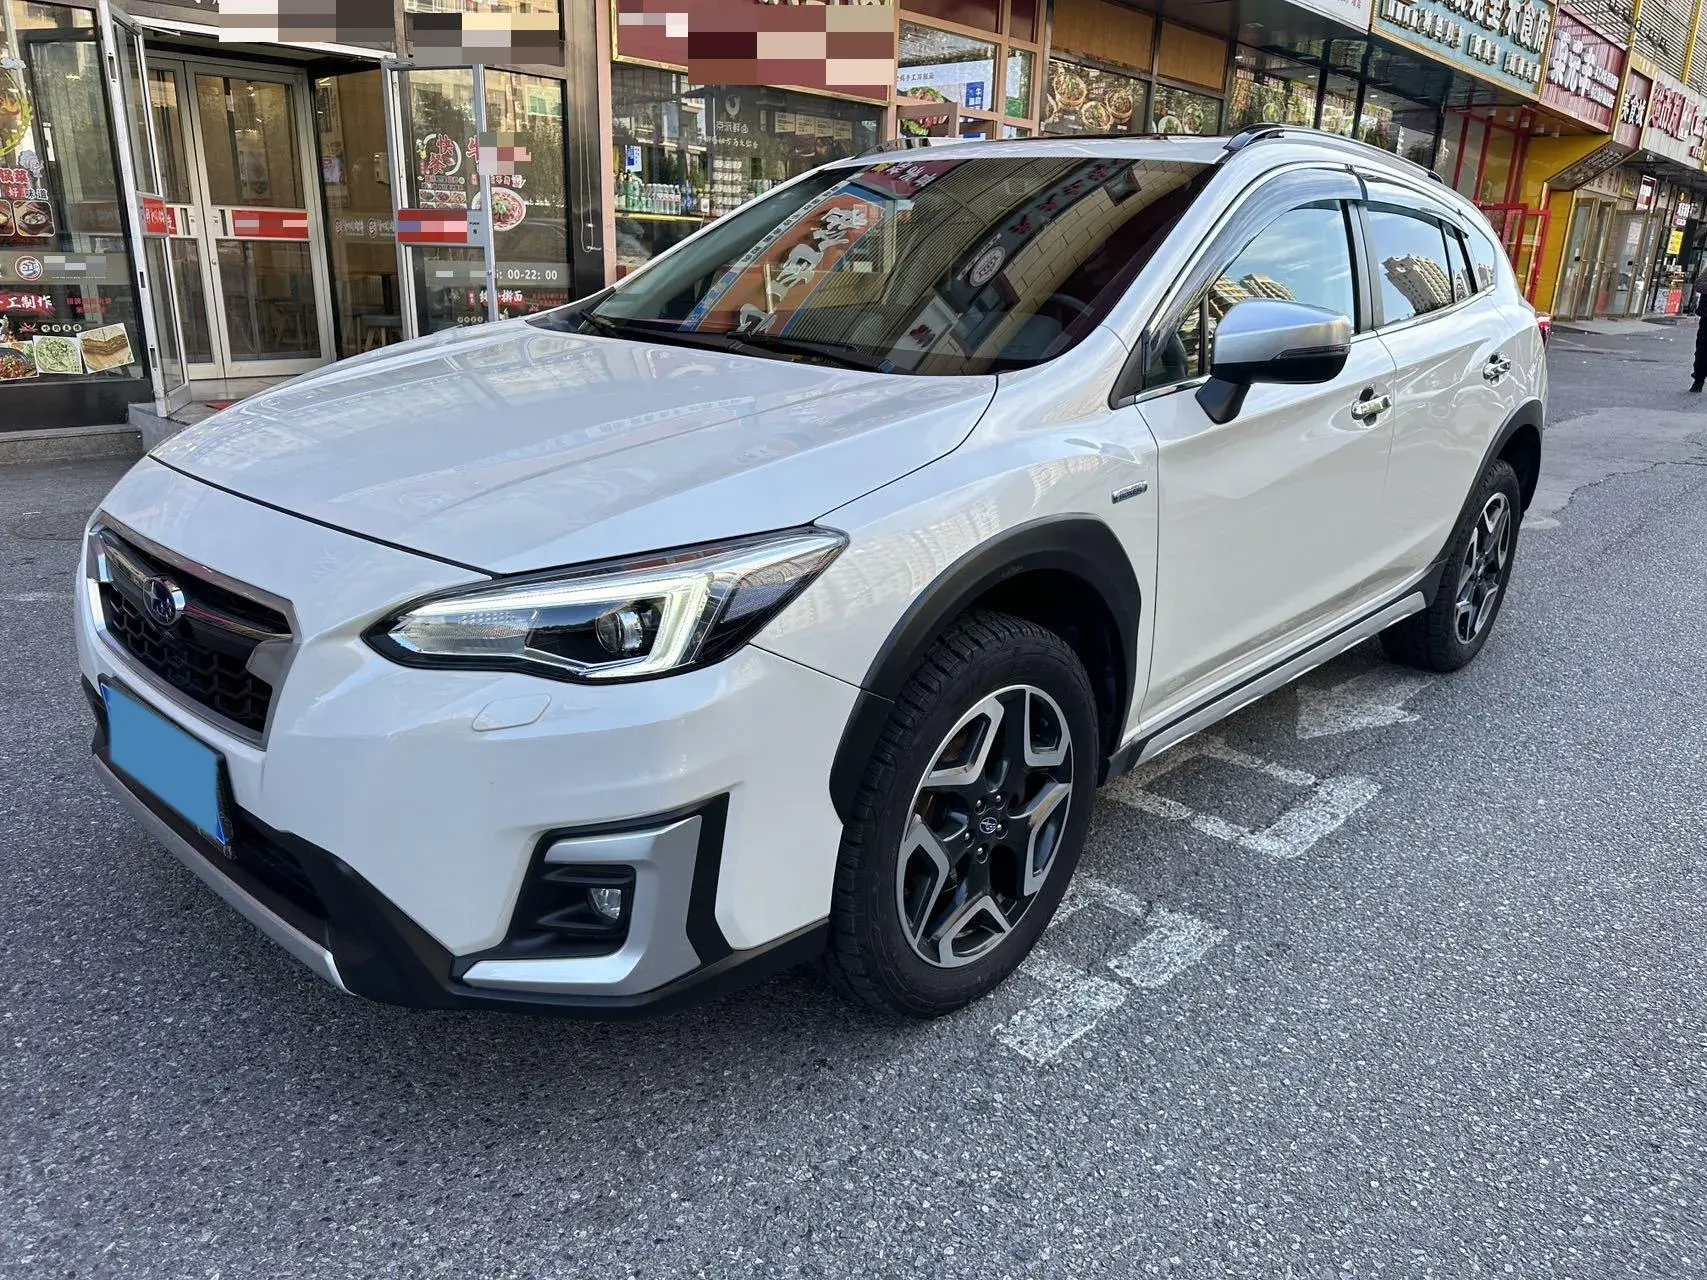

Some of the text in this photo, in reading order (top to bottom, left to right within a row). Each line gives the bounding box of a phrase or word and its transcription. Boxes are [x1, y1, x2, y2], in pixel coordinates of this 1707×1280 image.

[1622, 91, 1646, 127] 美食城
[0, 294, 53, 309] 工制作
